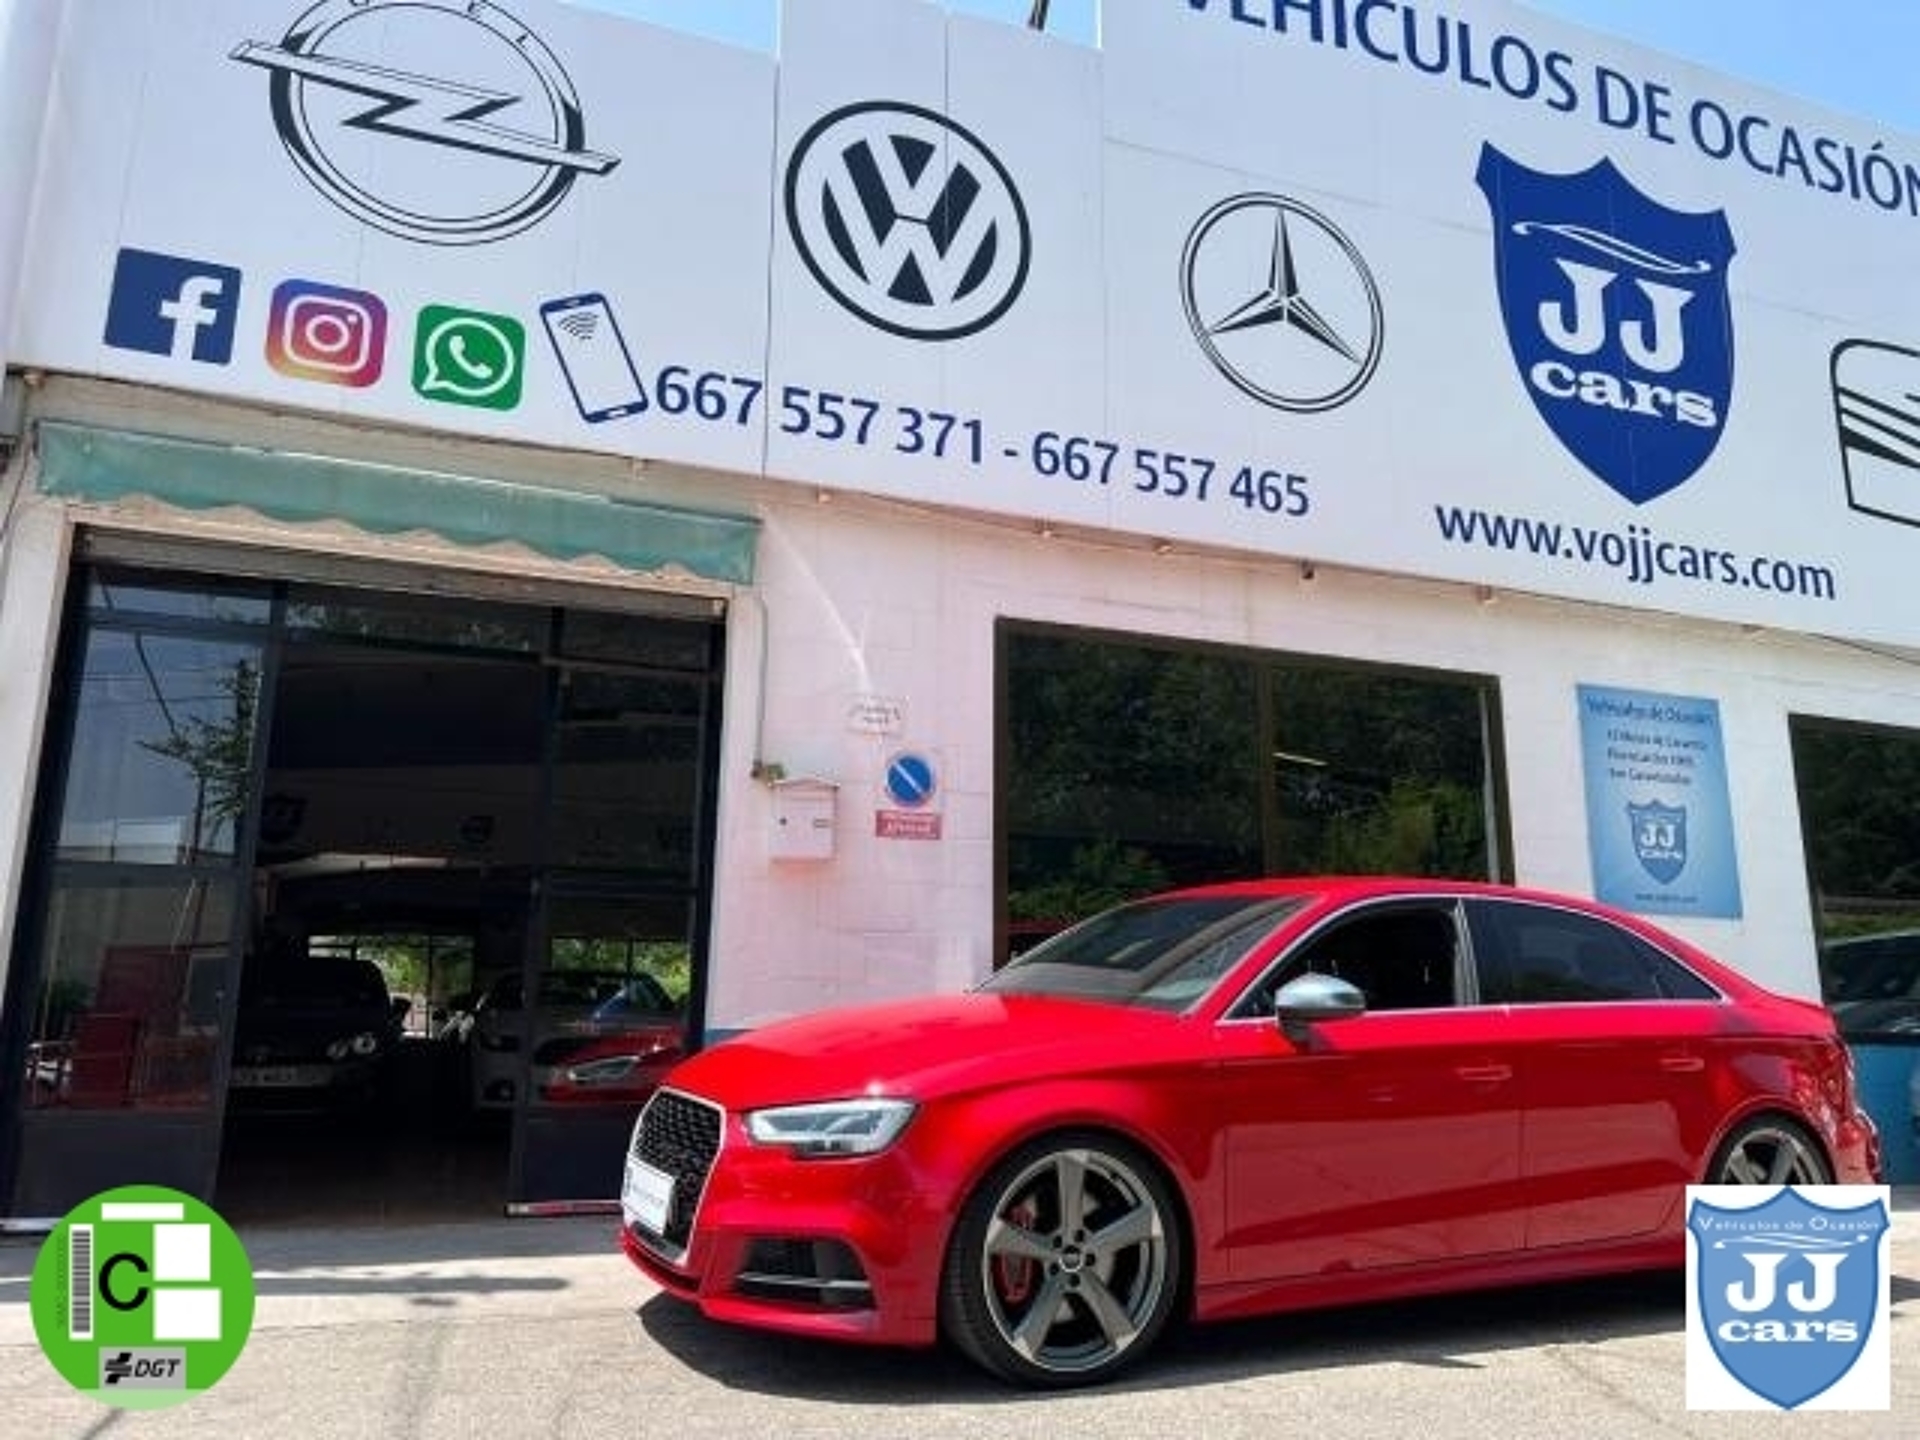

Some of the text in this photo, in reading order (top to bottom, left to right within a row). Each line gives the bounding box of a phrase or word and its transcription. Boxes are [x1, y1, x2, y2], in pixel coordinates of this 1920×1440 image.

[1595, 65, 1675, 144] DE
[1538, 257, 1695, 373] JJ
[655, 365, 763, 426] 667
[780, 385, 880, 445] 557
[895, 407, 983, 464] 371
[1032, 431, 1120, 484] 667
[1134, 448, 1216, 501] 557
[1229, 466, 1310, 516] 465
[1530, 360, 1718, 428] cars
[1435, 504, 1836, 600] www.vojjcars.com
